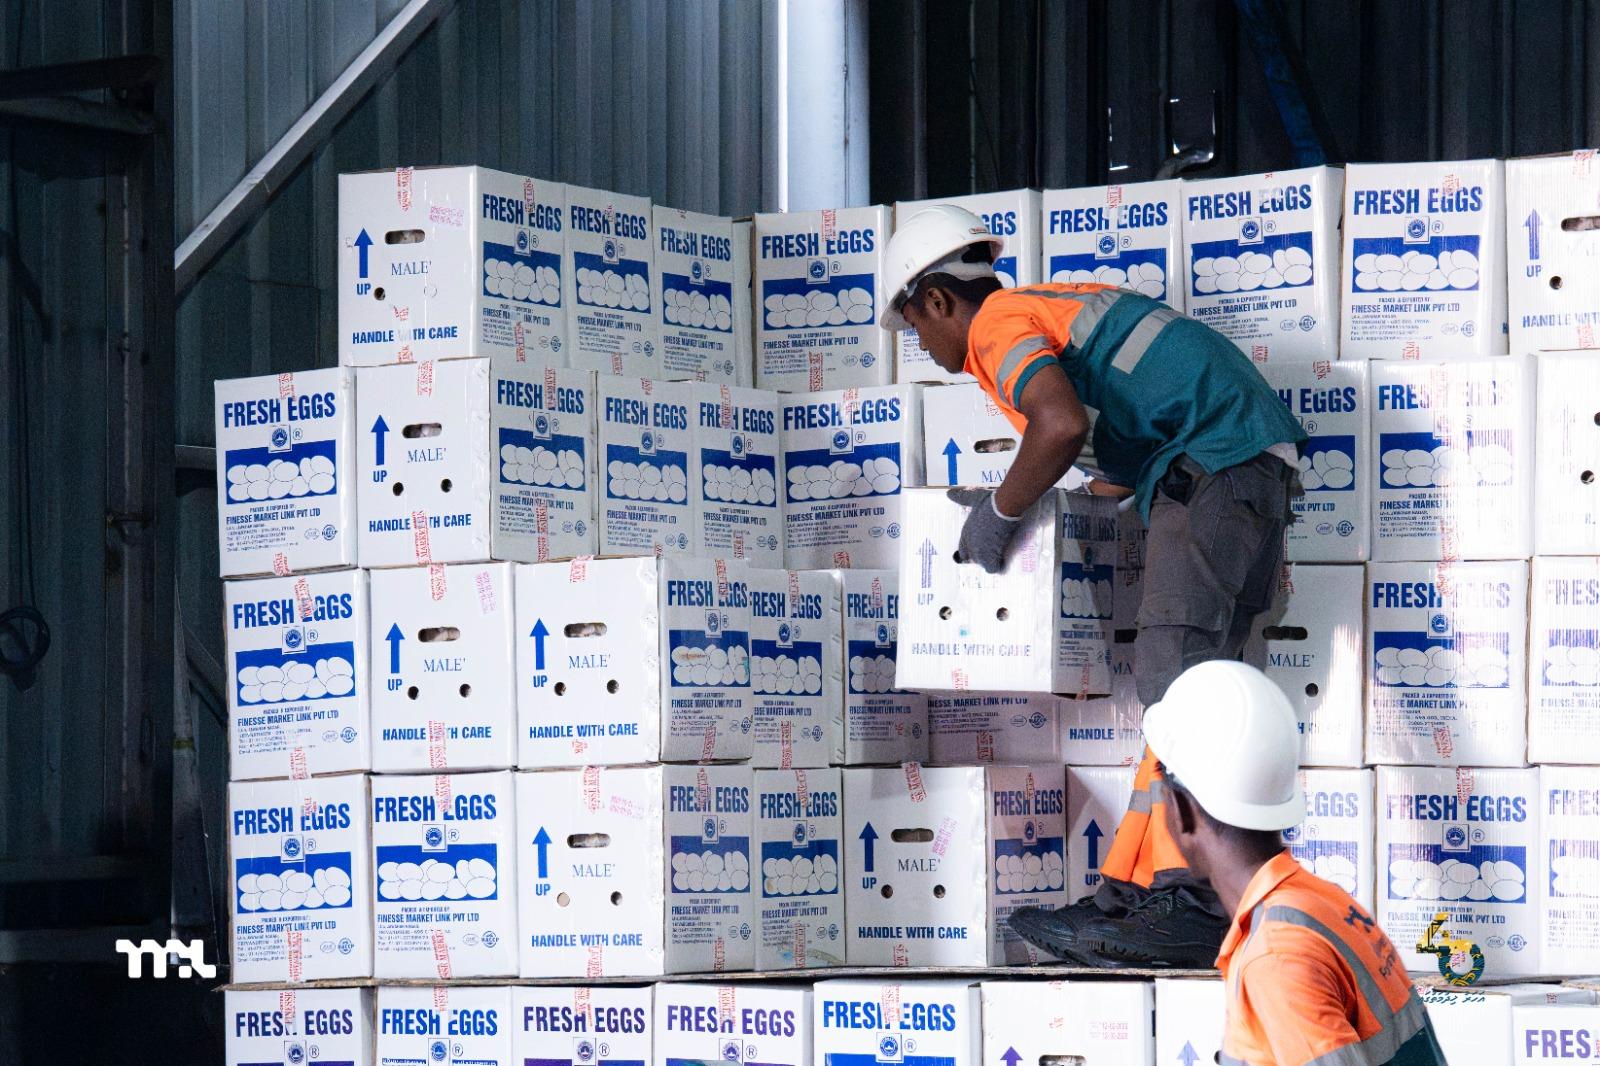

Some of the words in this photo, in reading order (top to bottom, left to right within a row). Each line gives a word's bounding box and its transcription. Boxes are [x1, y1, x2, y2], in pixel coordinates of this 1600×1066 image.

[483, 193, 523, 224] FRESH
[1189, 191, 1251, 221] FRESH
[1353, 189, 1419, 215] FRESH
[1428, 187, 1483, 213] EGGS
[571, 206, 610, 234] FRESH
[615, 213, 646, 240] EGGS
[661, 228, 698, 256] FRESH
[701, 234, 731, 262] EGGS
[762, 232, 819, 258] FRESH
[1527, 266, 1542, 277] UP
[357, 284, 371, 295] UP
[1193, 305, 1221, 316] FINESSE
[1223, 303, 1250, 314] MARKET
[1252, 302, 1268, 312] LINK
[1270, 300, 1283, 310] PVT
[1286, 299, 1296, 308] LTD
[1352, 305, 1380, 313] FINESSE
[1383, 304, 1413, 313] MARKET
[1414, 303, 1430, 312] LINK
[1432, 303, 1446, 312] PVT
[1448, 303, 1460, 311] LTD
[353, 330, 394, 344] HANDLE
[429, 326, 458, 339] CARE
[763, 340, 790, 349] FINESSE
[792, 339, 817, 347] MARKET
[819, 338, 833, 347] LINK
[835, 337, 847, 346] PVT
[848, 336, 858, 345] LTD
[498, 379, 542, 409] FRESH
[548, 388, 584, 414] GGS
[1303, 386, 1356, 414] EGGS
[224, 398, 280, 428] FRESH
[289, 392, 336, 421] EGGS
[606, 397, 648, 426] FRESH
[653, 402, 687, 430] EGGS
[700, 402, 739, 429] FREH
[743, 408, 773, 434] EGGS
[373, 471, 387, 482] UP
[787, 513, 814, 522] FINESSE
[815, 511, 841, 520] MARKET
[843, 509, 858, 519] LINK
[859, 508, 872, 517] PVT
[874, 507, 884, 516] LTD
[1307, 502, 1321, 511] PVT
[1322, 501, 1335, 511] LTD
[1380, 501, 1412, 510] FINESSE
[226, 515, 252, 525] FINESSE
[254, 512, 278, 522] MARKET
[280, 510, 295, 520] LINK
[297, 509, 308, 517] PVT
[309, 508, 320, 516] LTD
[369, 519, 411, 532] HANDLE
[444, 514, 471, 526] CARE
[668, 581, 712, 606] FRESH
[1373, 582, 1442, 608] FRESH
[233, 599, 293, 629] FRESH
[302, 593, 352, 622] GGS
[388, 679, 402, 691] UP
[533, 676, 547, 687] UP
[954, 697, 981, 707] MARKET
[983, 697, 999, 706] LINK
[1001, 697, 1014, 705] PVT
[1407, 700, 1437, 709] MARKET
[238, 717, 265, 727] FINESSE
[268, 715, 294, 725] MARKET
[297, 714, 311, 722] LINK
[314, 712, 325, 720] PVT
[327, 710, 338, 718] LTD
[383, 728, 426, 740] HANDLE
[462, 726, 491, 738] CARE
[530, 726, 572, 738] HANDLE
[577, 724, 604, 736] WITH
[609, 723, 638, 736] CARE
[1070, 729, 1114, 739] HANDLE
[716, 787, 749, 813] EGGS
[761, 792, 801, 818] FRESH
[994, 789, 1030, 816] FRESH
[1035, 790, 1062, 815] EGGS
[1467, 795, 1526, 822] EGGS
[375, 797, 435, 822] FRESH
[234, 807, 293, 835] FRESH
[862, 877, 876, 889] UP
[1085, 874, 1100, 886] UP
[536, 884, 550, 896] UP
[377, 914, 404, 923] FINESSE
[406, 913, 433, 922] MARKET
[435, 913, 451, 922] LINK
[453, 913, 466, 922] PVT
[467, 913, 479, 922] LTD
[1456, 913, 1474, 924] LINK
[1475, 914, 1490, 924] PVT
[1492, 914, 1505, 924] LTD
[237, 924, 264, 935] FINESSE
[311, 922, 323, 930] PVT
[325, 921, 336, 929] LTD
[859, 927, 902, 939] HANDLE
[906, 927, 934, 939] WITH
[938, 927, 967, 939] CARE
[531, 935, 576, 947] HANDLE
[580, 935, 608, 946] WITH
[613, 934, 642, 946] CARE
[236, 1012, 297, 1037] FRES
[305, 1009, 353, 1037] EGGS
[382, 1009, 440, 1035] FRESH
[595, 1007, 645, 1033] EGGS
[742, 1008, 795, 1037] EGGS
[900, 1002, 956, 1032] EGGS
